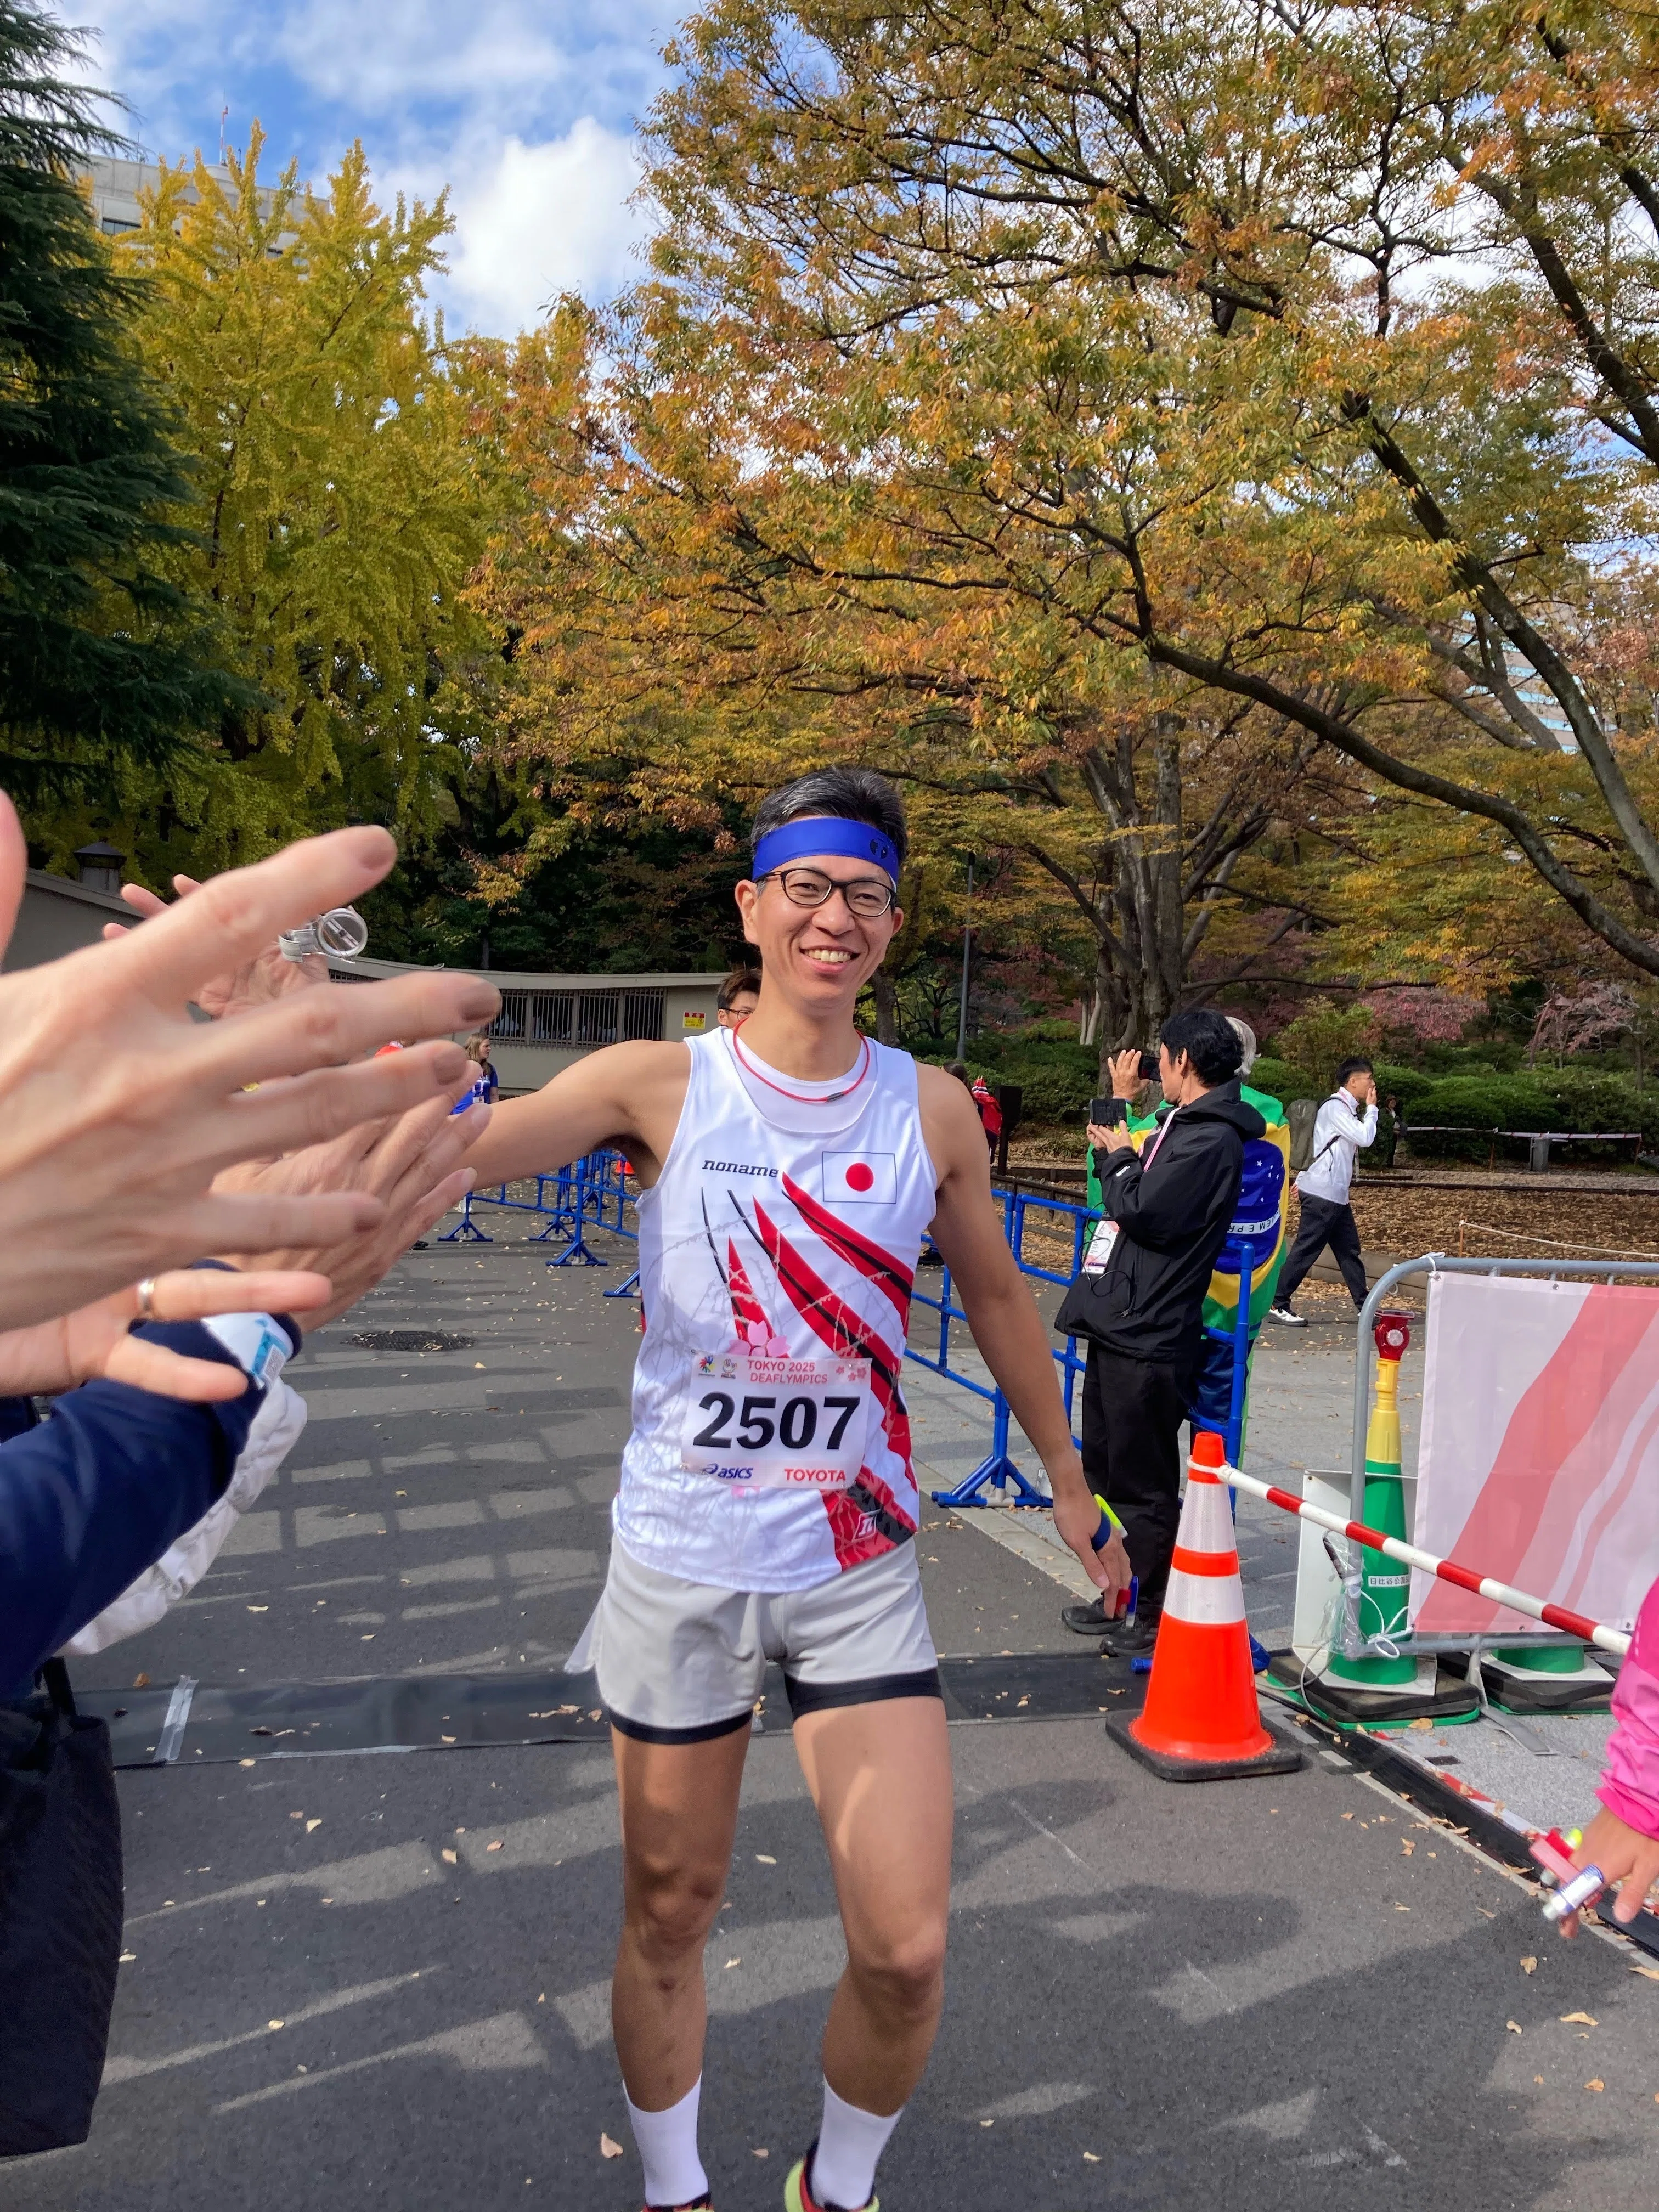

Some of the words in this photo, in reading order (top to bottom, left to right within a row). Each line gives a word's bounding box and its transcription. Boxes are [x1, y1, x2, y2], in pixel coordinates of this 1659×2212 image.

[702, 1160, 780, 1178] noname
[747, 1359, 786, 1372] TOKYO
[789, 1362, 815, 1372] 2025
[750, 1372, 828, 1384] DEAFLYMPICS
[693, 1391, 861, 1450] 2507
[784, 1468, 847, 1482] TOYOTA
